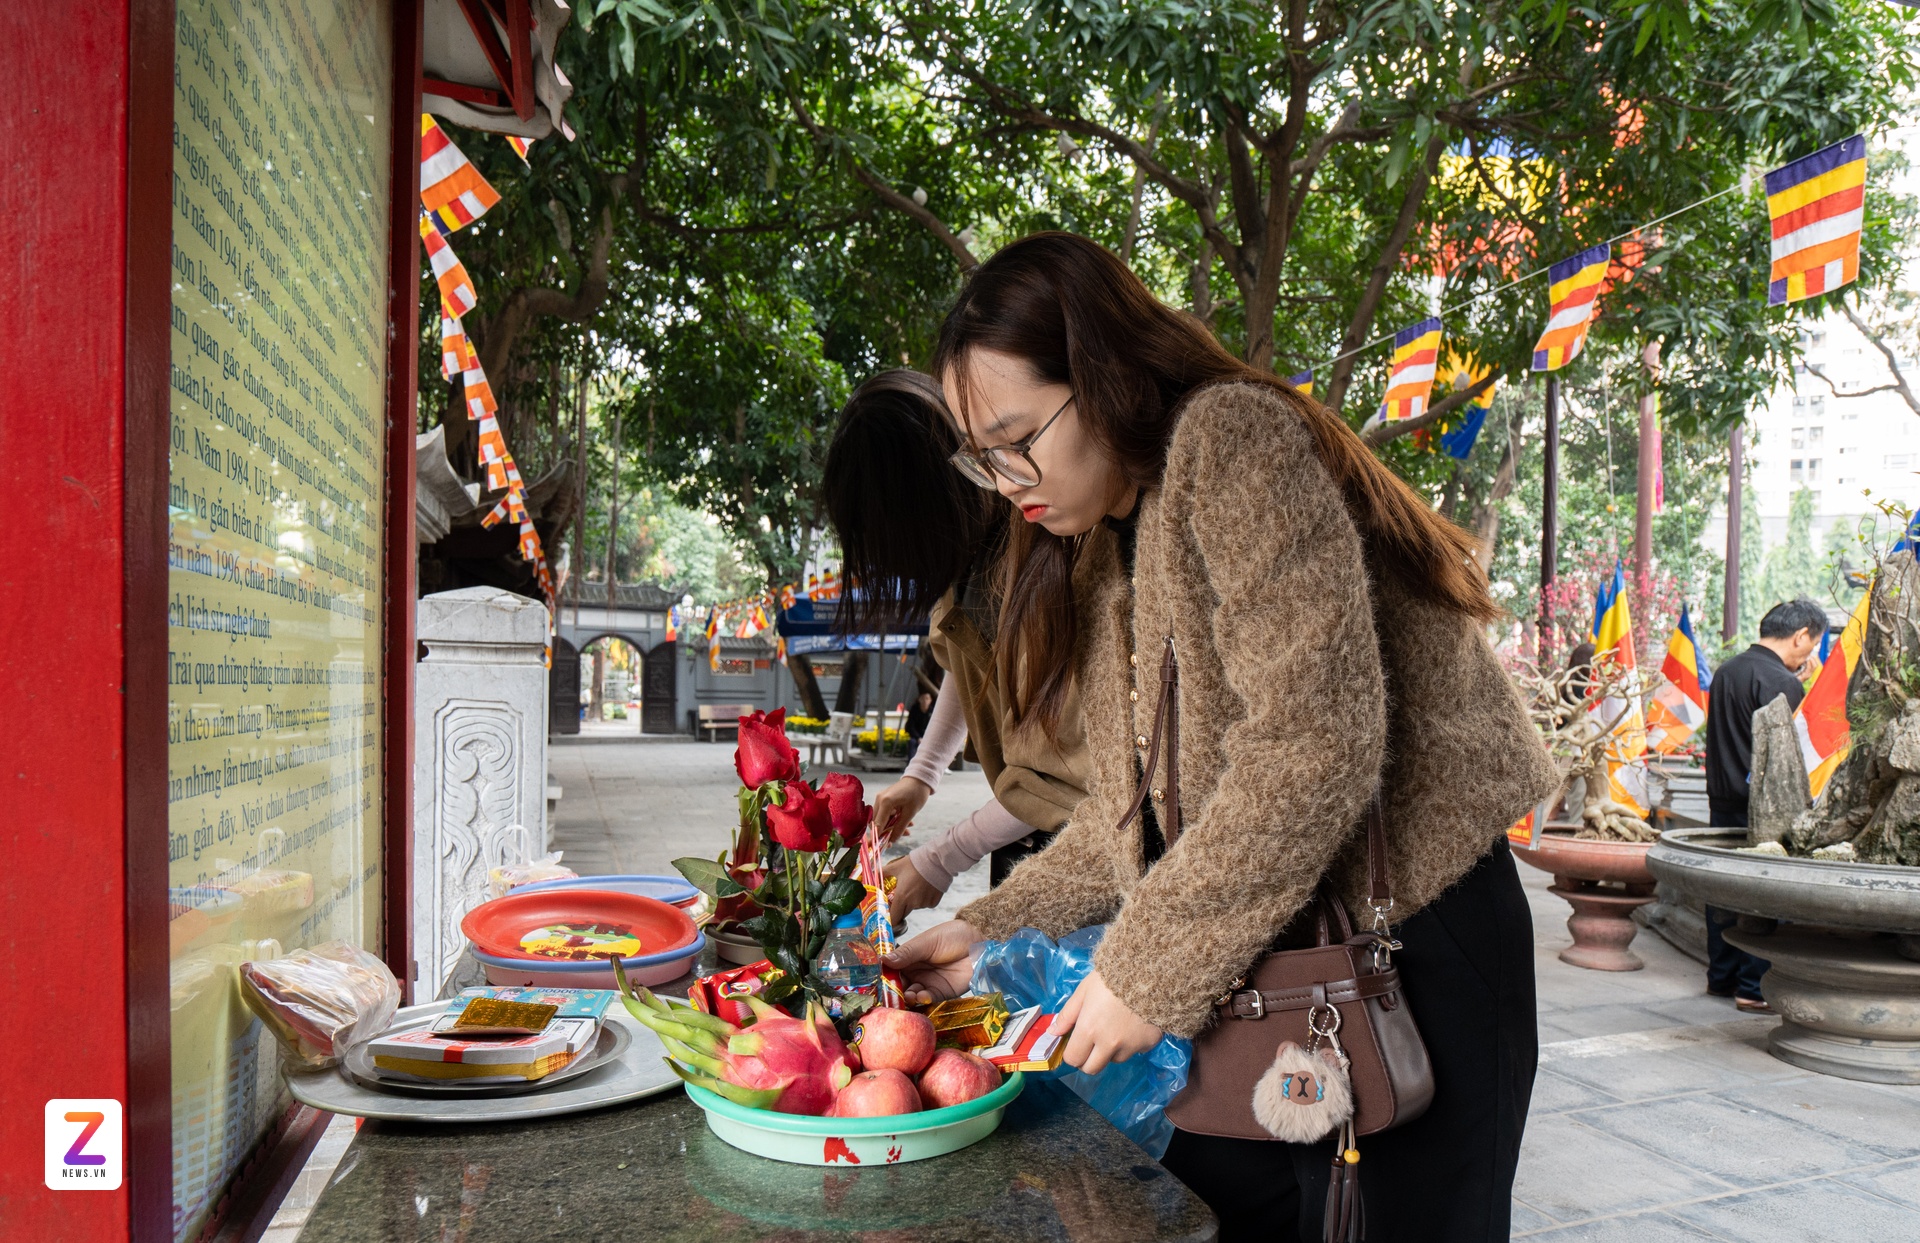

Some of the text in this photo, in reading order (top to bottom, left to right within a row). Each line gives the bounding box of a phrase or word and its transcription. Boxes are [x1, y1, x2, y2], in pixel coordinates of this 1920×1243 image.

[209, 0, 228, 54] sưu
[234, 40, 248, 95] tập
[251, 69, 260, 109] di
[264, 99, 276, 138] vật
[279, 126, 288, 158] có
[246, 16, 262, 64] nhà
[264, 46, 277, 92] thờ
[188, 81, 209, 133] quả
[212, 116, 248, 197] chuông
[249, 166, 270, 229] đồng
[272, 207, 287, 247] niên
[289, 226, 303, 270] hiệu
[221, 68, 249, 148] Trong
[287, 177, 298, 218] lưu
[299, 200, 304, 234] ý
[305, 215, 319, 252] nhất
[319, 232, 325, 261] là
[172, 172, 189, 222] Từ
[191, 203, 215, 252] năm
[219, 229, 241, 282] 1941
[244, 258, 259, 303] đến
[261, 286, 278, 325] năm
[280, 303, 298, 354] 1945,
[299, 332, 314, 366] chùa
[315, 346, 323, 377] Hà
[324, 357, 329, 384] là
[182, 133, 209, 191] ngợi
[211, 172, 235, 224] cảnh
[237, 200, 253, 255] đẹp
[255, 231, 265, 262] và
[265, 245, 275, 281] sự
[276, 252, 290, 295] linh
[291, 277, 311, 329] thiêng
[312, 307, 322, 336] của
[191, 319, 219, 364] quan
[223, 345, 240, 382] gác
[242, 363, 273, 419] chuông
[275, 393, 292, 428] chùa
[295, 407, 304, 438] Hà
[306, 417, 319, 451] diễn
[320, 437, 326, 457] ra
[327, 438, 336, 469] hội
[198, 260, 219, 311] làm
[222, 295, 235, 327] cơ
[237, 309, 248, 341] sở
[250, 317, 269, 365] hoạt
[270, 339, 289, 389] động
[290, 360, 298, 391] bí
[326, 399, 332, 425] 15
[333, 408, 347, 446] tháng
[352, 430, 361, 455] năm
[194, 427, 221, 473] Năm
[226, 447, 250, 497] 1984,
[254, 466, 266, 507] Uỷ
[343, 524, 350, 547] Hà
[202, 376, 212, 421] bị
[215, 392, 234, 429] cho
[236, 411, 257, 448] cuộc
[258, 416, 276, 467] tổng
[277, 436, 293, 472] khởi
[294, 455, 312, 485] nghĩa
[313, 464, 328, 497] Cách
[193, 486, 206, 519] và
[210, 486, 229, 533] gắn
[231, 499, 251, 539] biển
[254, 513, 261, 543] di
[264, 520, 278, 550] tích
[168, 592, 272, 644] ch lịch sử nghệ thuật.
[187, 540, 211, 576] năm
[216, 547, 242, 592] 1996,
[244, 560, 264, 591] chùa
[267, 566, 277, 595] Hà
[279, 571, 296, 605] được
[298, 577, 307, 609] Bộ
[309, 581, 320, 607] Văn
[168, 650, 191, 684] Trải
[194, 662, 214, 694] qua
[217, 654, 248, 693] những
[249, 656, 272, 692] thăng
[273, 652, 290, 684] trầm
[291, 660, 303, 684] của
[304, 660, 315, 689] lịch
[184, 708, 209, 742] theo
[212, 706, 234, 737] năm
[237, 704, 262, 740] tháng.
[265, 703, 283, 734] Diện
[285, 708, 299, 731] mạo
[301, 700, 315, 731] ngôi
[168, 775, 328, 862] ăm gần đây. Ngôi chùa thường xuyên
[185, 762, 221, 799] những
[223, 748, 238, 787] lần
[239, 752, 262, 786] trùng
[263, 752, 273, 780] tu,
[275, 746, 287, 772] sửa
[288, 742, 304, 769] chữa
[305, 740, 316, 764] vào
[242, 848, 257, 879] tâm
[293, 829, 303, 855] tạo
[303, 817, 318, 850] ngày
[318, 810, 329, 838] một
